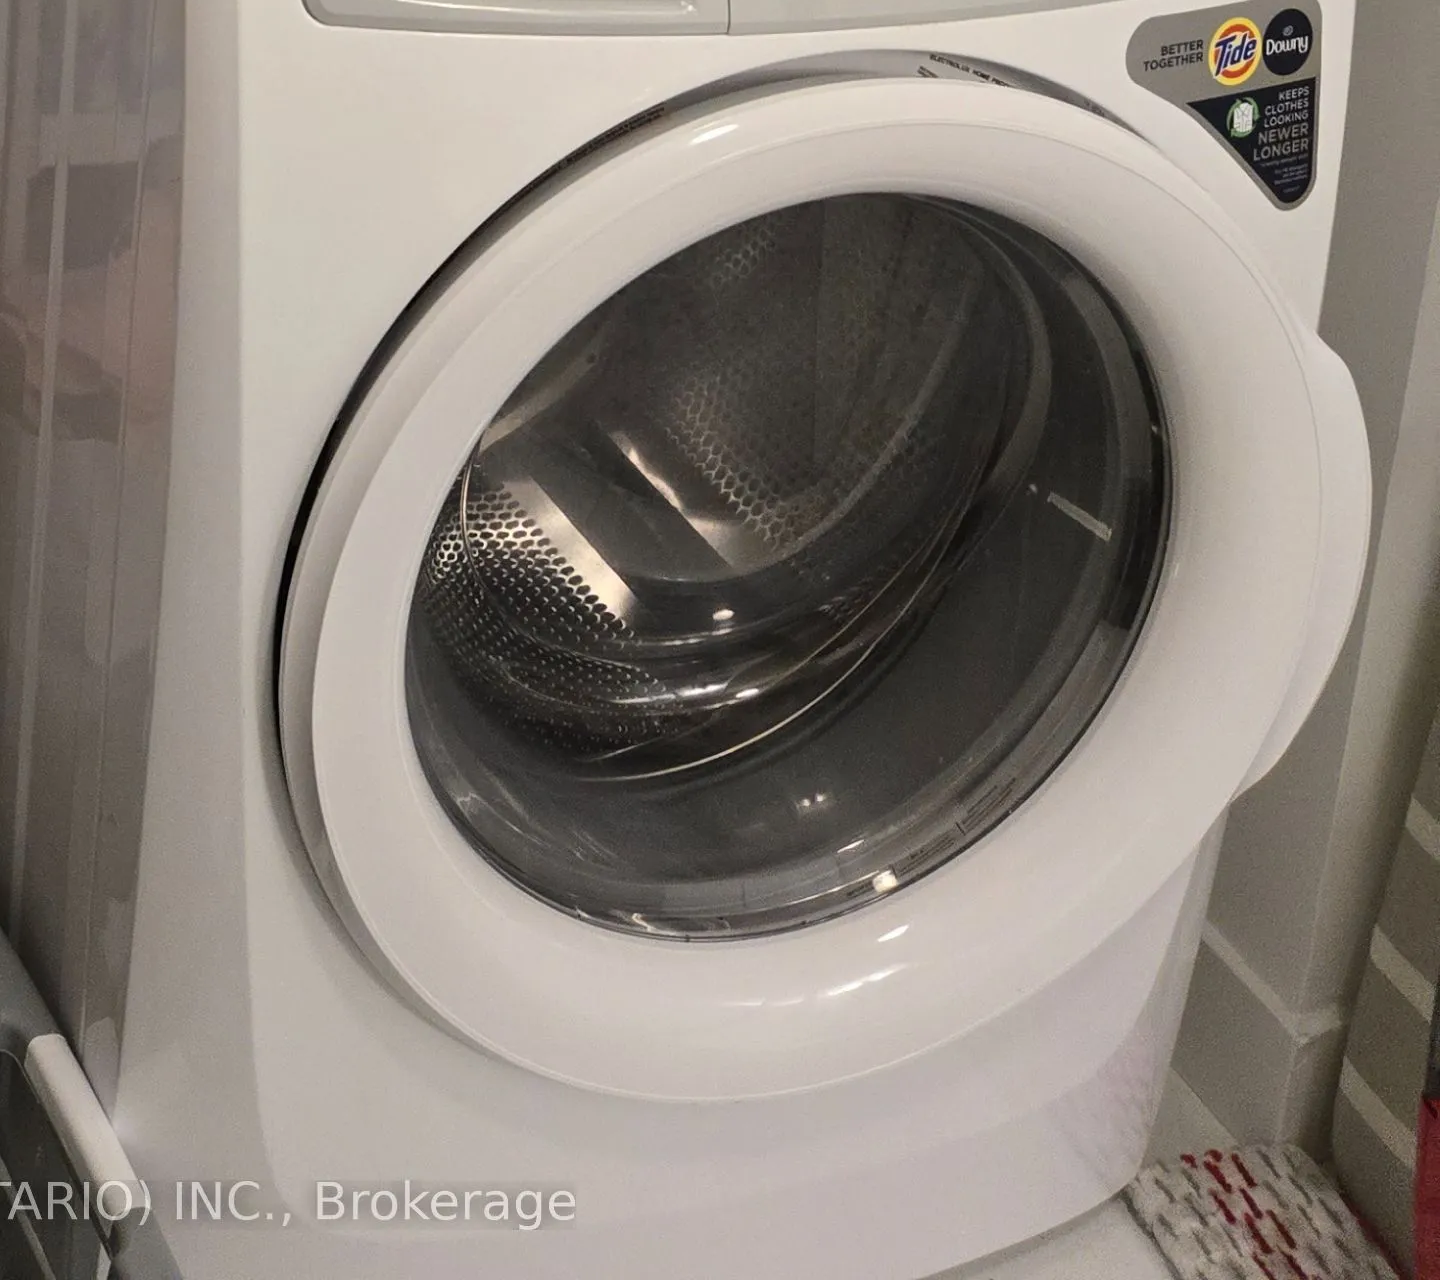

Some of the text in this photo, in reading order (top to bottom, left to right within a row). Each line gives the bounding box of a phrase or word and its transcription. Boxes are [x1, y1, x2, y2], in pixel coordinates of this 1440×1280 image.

[1161, 39, 1204, 57] BETTER
[1214, 32, 1258, 78] Tide
[1265, 35, 1309, 56] Downy
[1143, 51, 1204, 72] TOGETHER
[1278, 85, 1310, 101] KEEPS
[1264, 97, 1309, 117] CLOTHES
[1263, 110, 1309, 129] LOOKING
[1258, 122, 1309, 145] NEWER
[1253, 140, 1309, 161] LONGER
